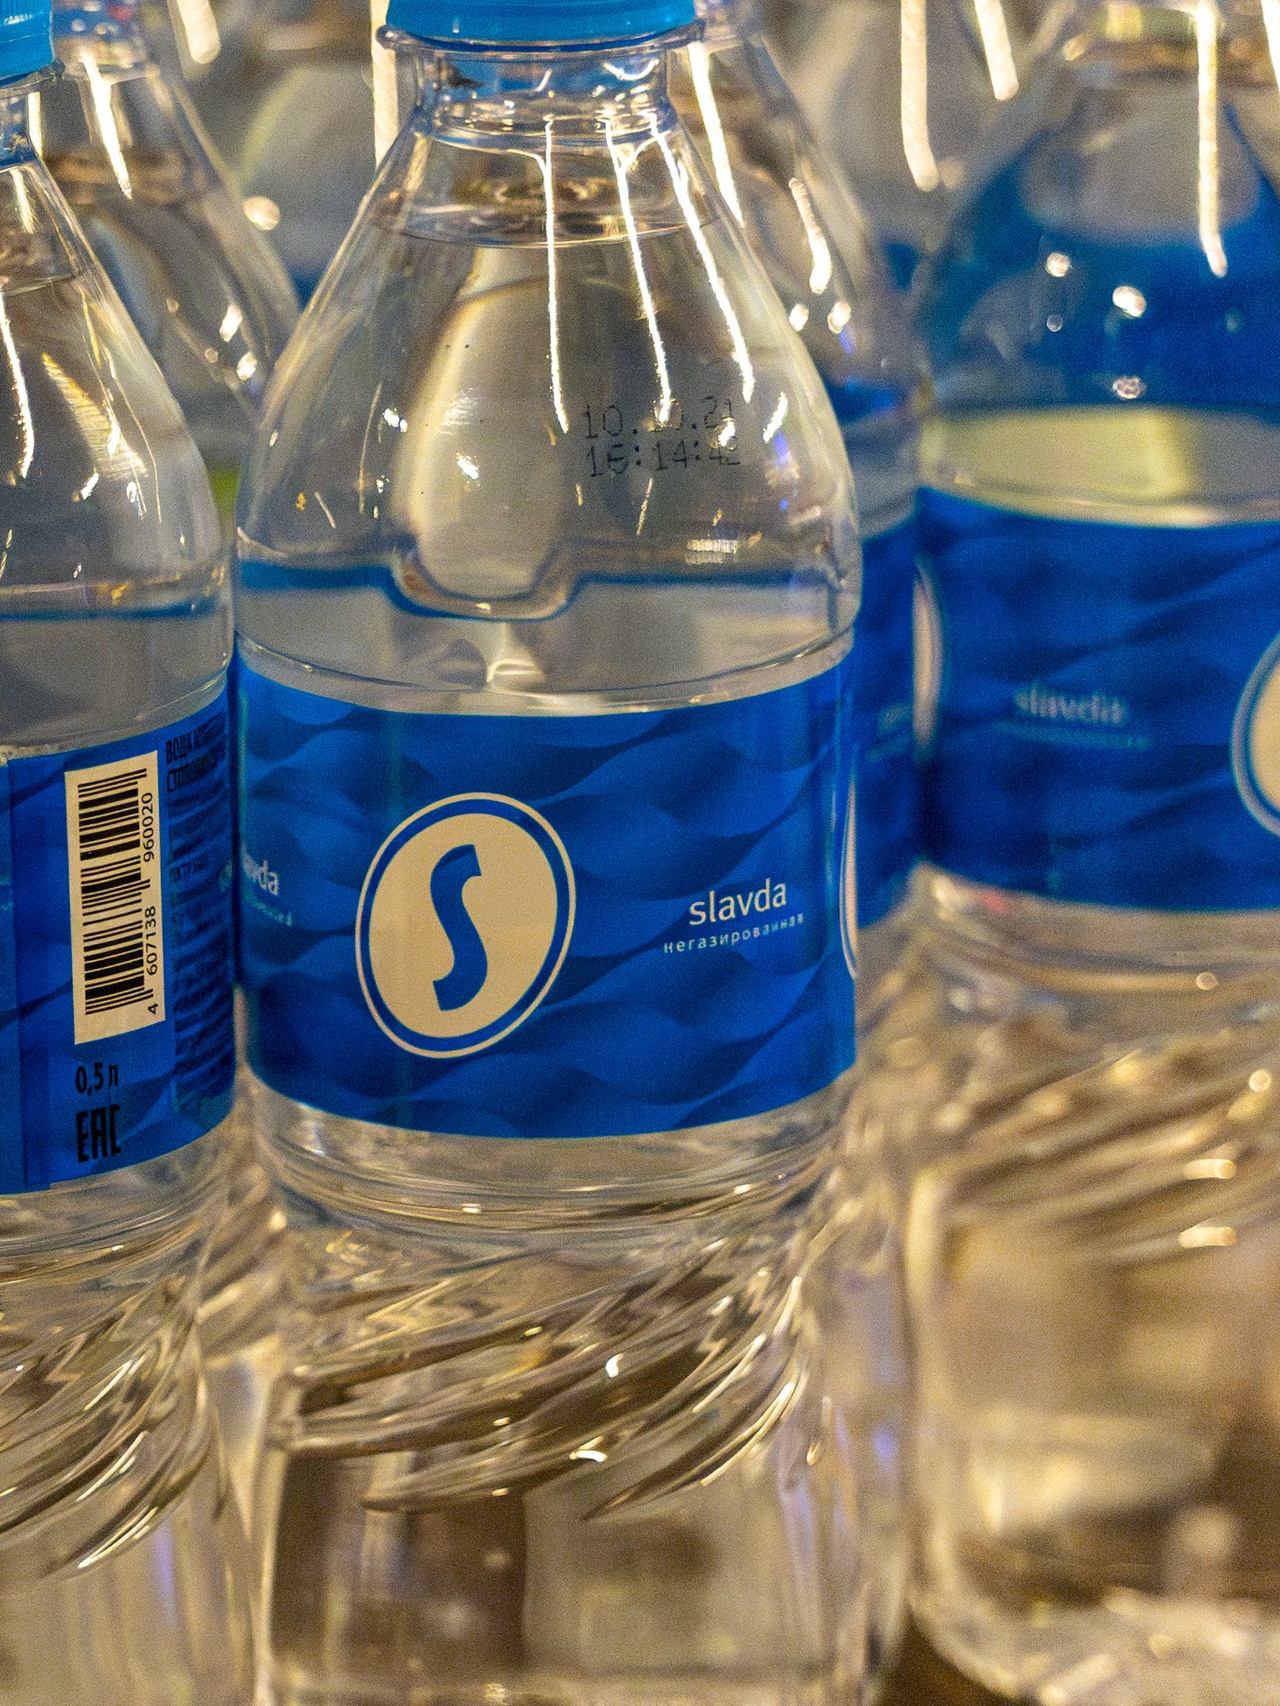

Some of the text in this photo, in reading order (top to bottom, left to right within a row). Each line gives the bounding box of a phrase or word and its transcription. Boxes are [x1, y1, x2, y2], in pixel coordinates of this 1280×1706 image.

[582, 395, 734, 440] 10.0.21
[140, 792, 159, 1015] 4 607138 960020
[688, 877, 787, 926] slavda
[75, 1062, 104, 1096] 0,5
